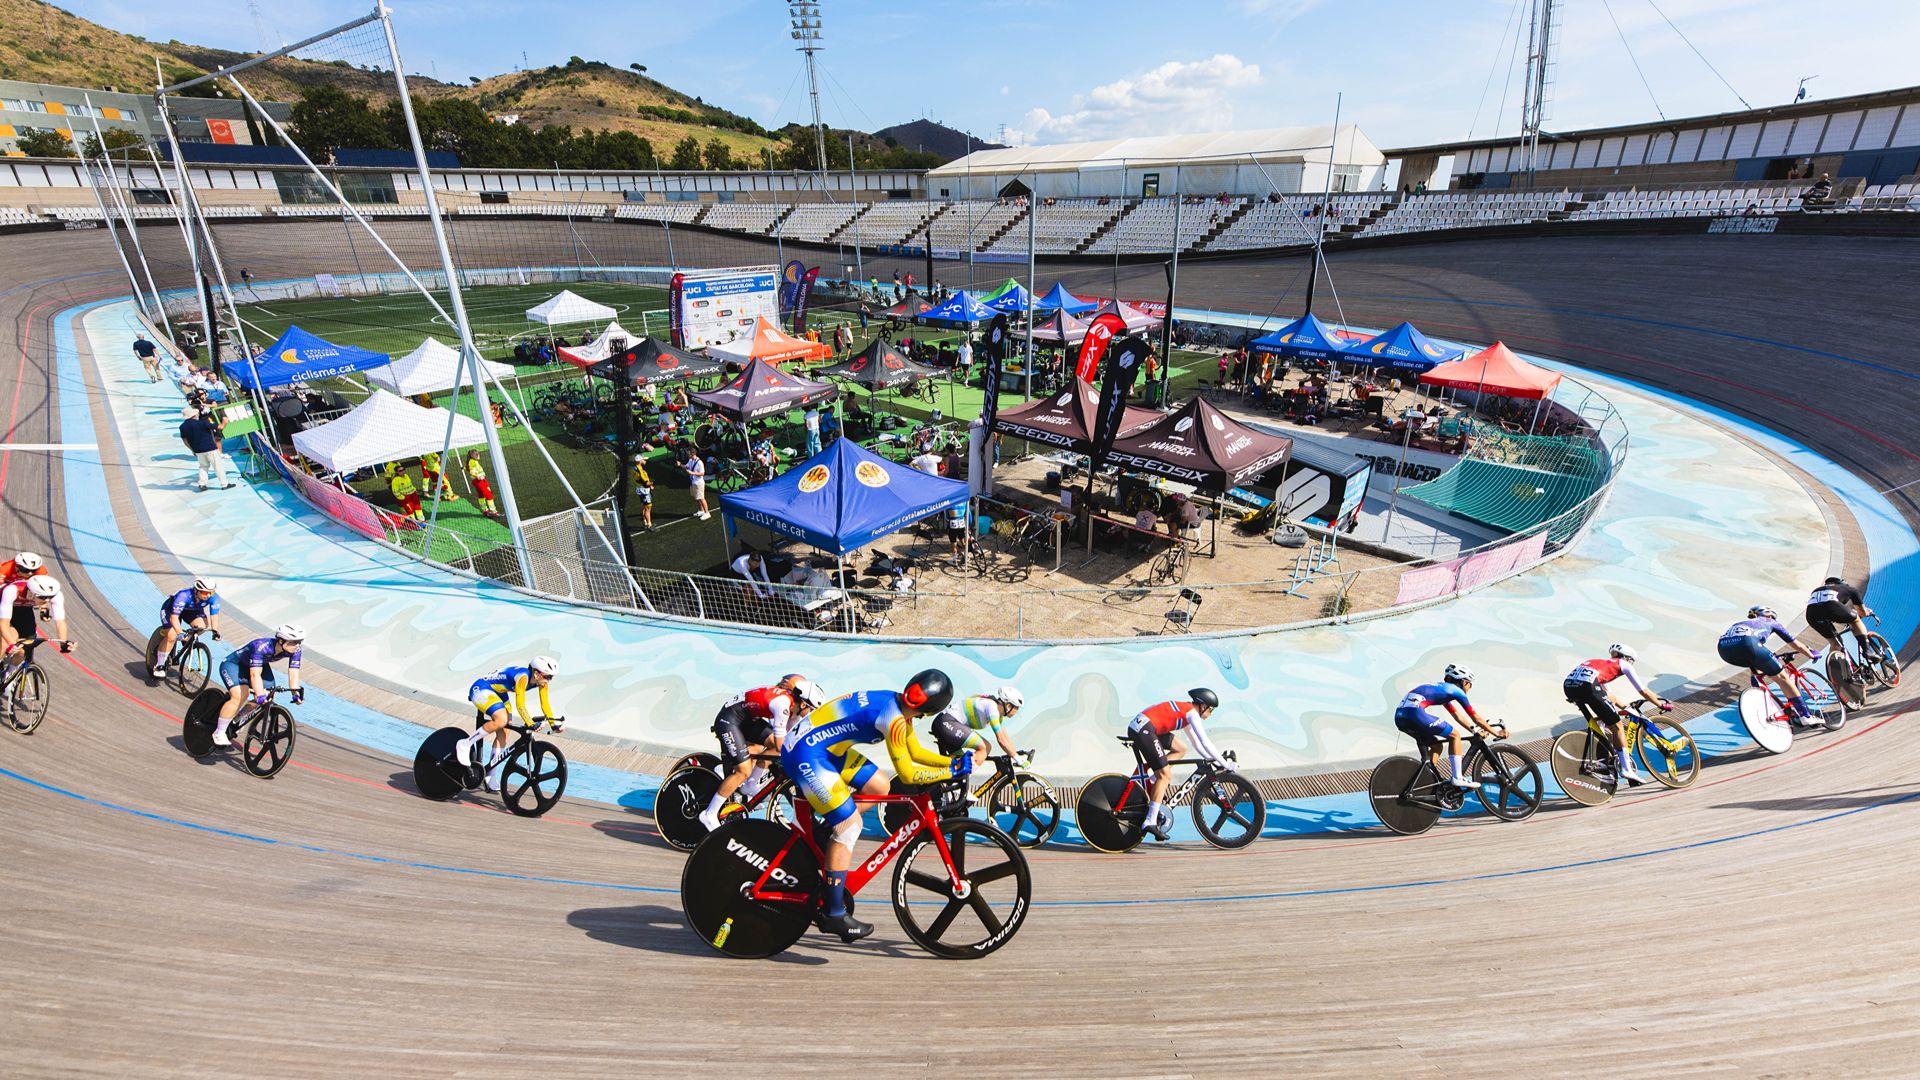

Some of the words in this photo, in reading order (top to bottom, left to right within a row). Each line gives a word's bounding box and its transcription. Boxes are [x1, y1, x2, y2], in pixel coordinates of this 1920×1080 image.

[762, 353, 785, 361] Generalitat
[792, 348, 812, 356] Catalunya
[1256, 345, 1282, 353] ciclisme.cat
[1299, 350, 1327, 358] ciclisme.cat
[1344, 355, 1373, 363] ciclisme.cat
[291, 363, 357, 382] ciclisme.cat
[1392, 360, 1424, 369] ciclisme.cat
[995, 421, 1078, 448] SPEEDSIX
[1106, 451, 1209, 482] SPEEDSIX
[1233, 447, 1287, 483] SPEEDSIX
[871, 519, 901, 537] Federació
[901, 509, 926, 526] Catalana
[926, 499, 950, 514] Ciclisme
[805, 722, 859, 747] CATALUNYA
[1627, 727, 1637, 749] LOOK
[1153, 739, 1164, 758] NOR
[798, 762, 833, 805] CATALUNYA
[1168, 773, 1202, 810] KOGA
[1564, 777, 1609, 794] CORIMA
[866, 818, 920, 873] cervélo
[726, 838, 799, 888] CORIMA
[898, 841, 929, 908] CORIMA
[973, 896, 1025, 950] CORIMA
